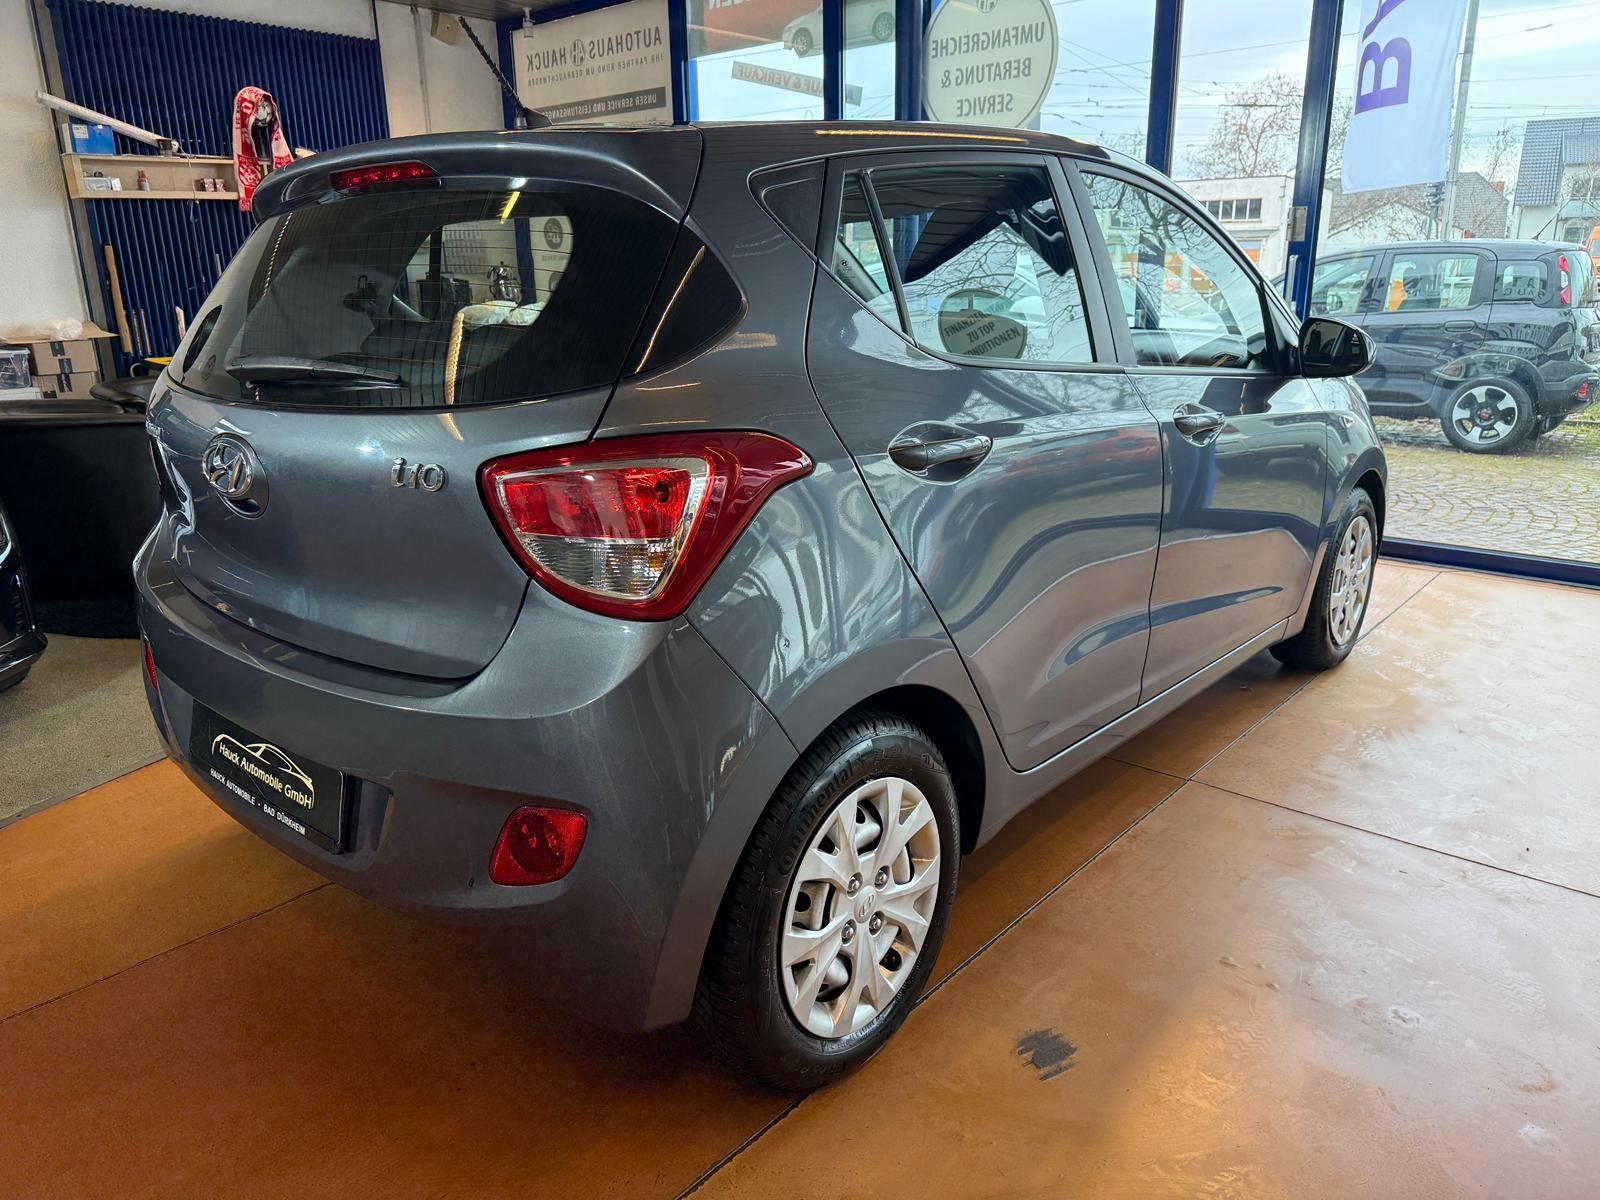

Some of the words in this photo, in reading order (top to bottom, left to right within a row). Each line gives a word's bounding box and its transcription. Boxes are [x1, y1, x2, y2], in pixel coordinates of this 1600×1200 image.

[964, 326, 1021, 356] ONDITIONEN
[391, 457, 446, 493] i10
[210, 768, 226, 785] HAUCK
[226, 779, 256, 806] AUTOMOBILE
[263, 803, 275, 818] BAD
[276, 811, 306, 836] DÜRKHEIM
[218, 742, 240, 767] Hauck
[241, 757, 283, 793] Automobile
[284, 784, 313, 810] GmbH
